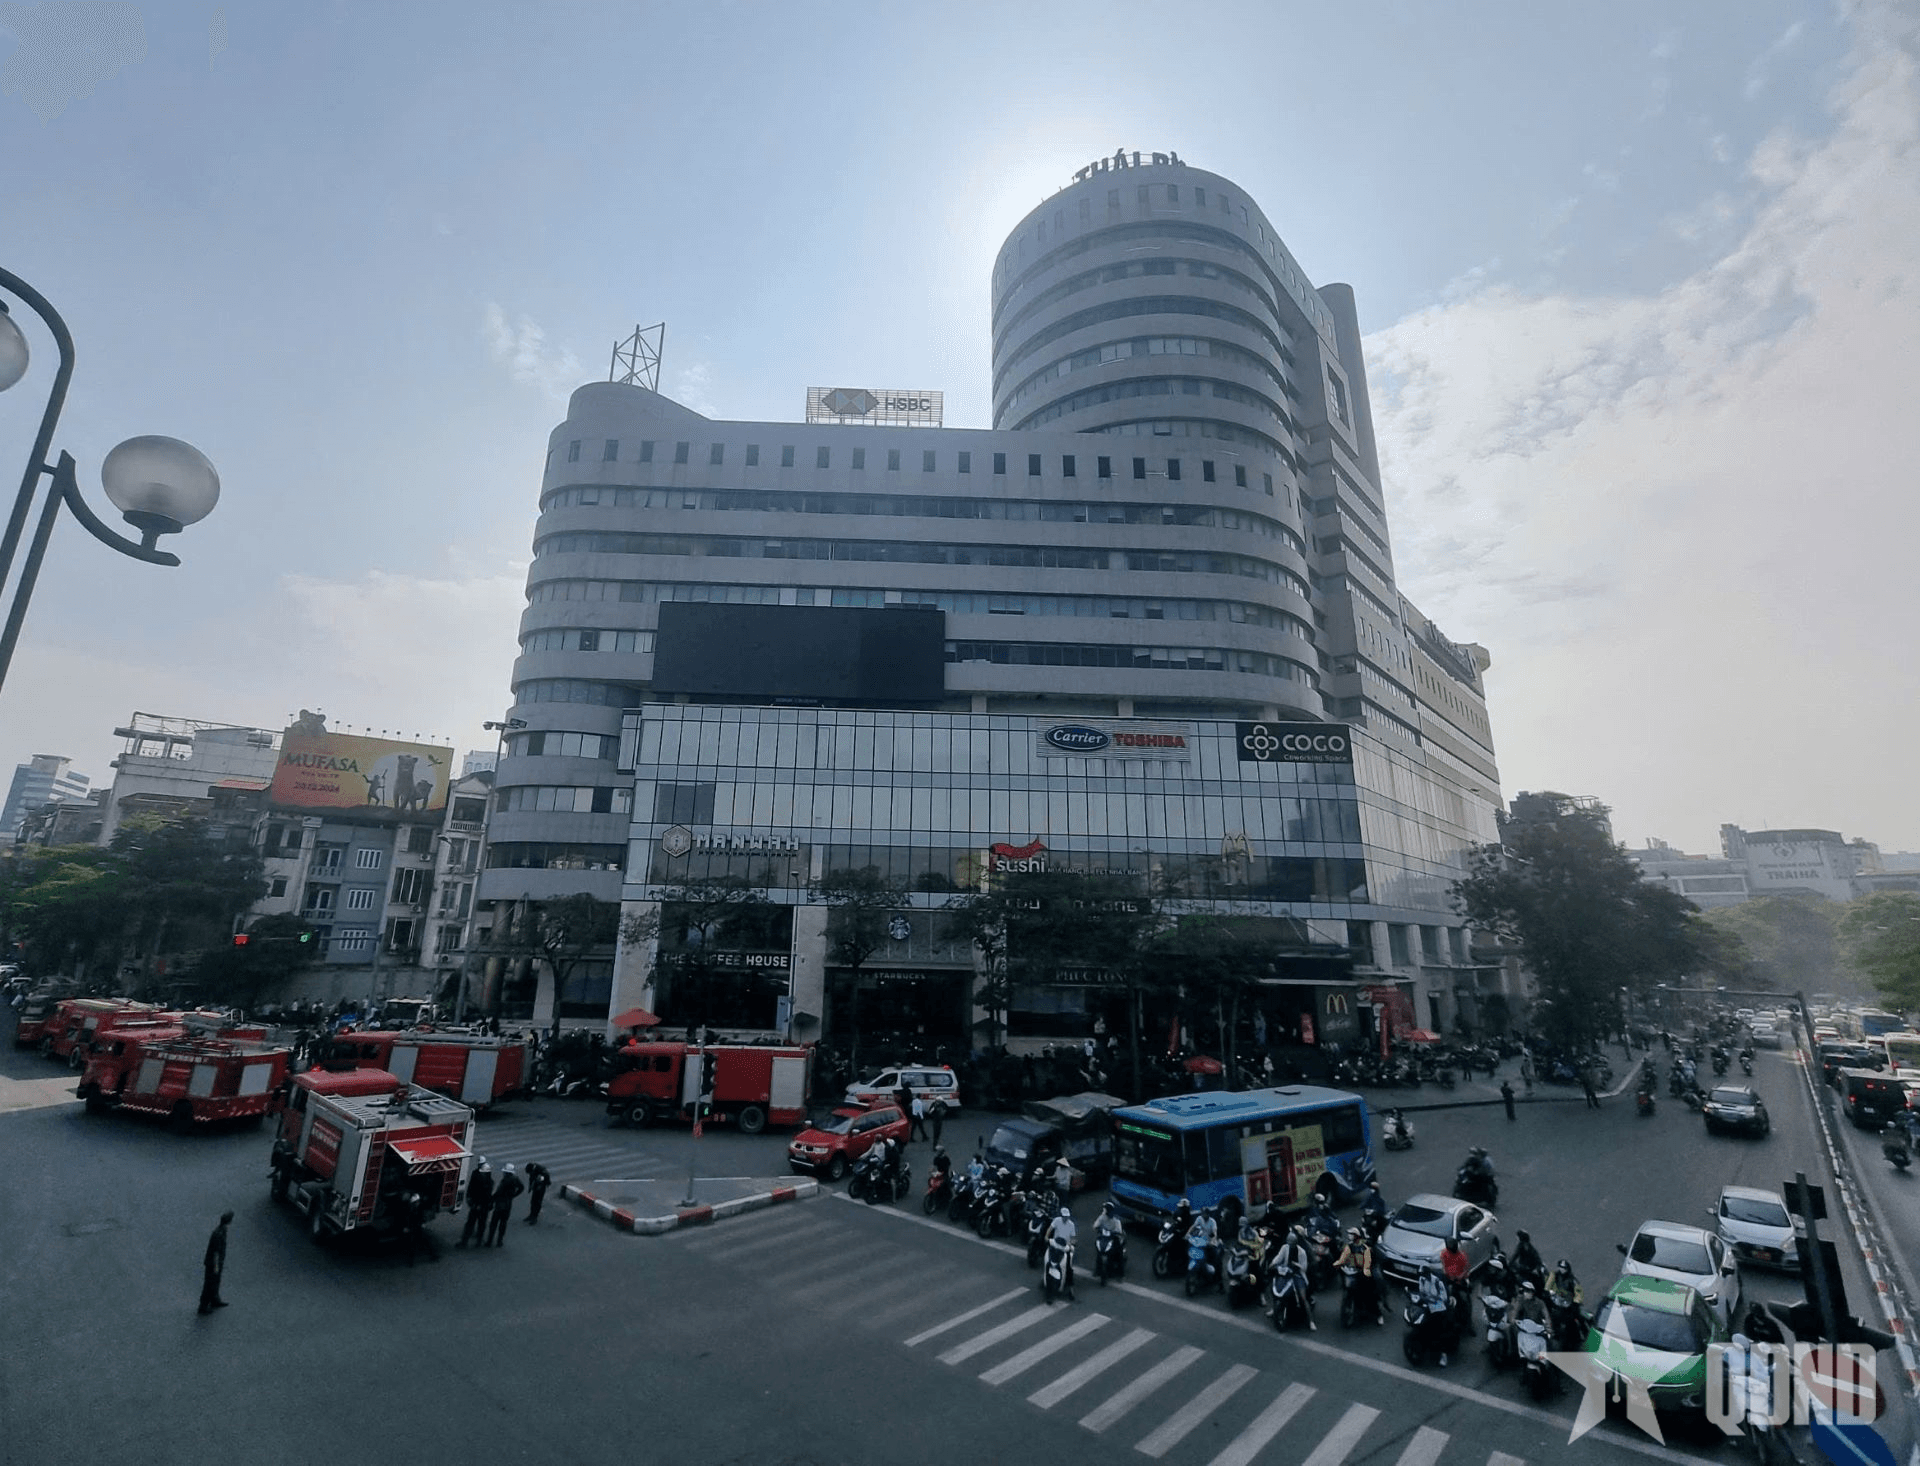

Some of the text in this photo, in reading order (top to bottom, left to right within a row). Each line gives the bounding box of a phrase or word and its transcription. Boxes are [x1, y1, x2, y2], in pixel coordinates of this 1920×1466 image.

[885, 397, 930, 411] HSBC
[1052, 729, 1185, 748] Carrier TOSHIBA
[1282, 734, 1346, 752] COGO
[284, 753, 359, 773] MUFASA
[696, 833, 800, 851] MANWAH
[996, 856, 1046, 873] sushi
[746, 953, 789, 968] HOUSE
